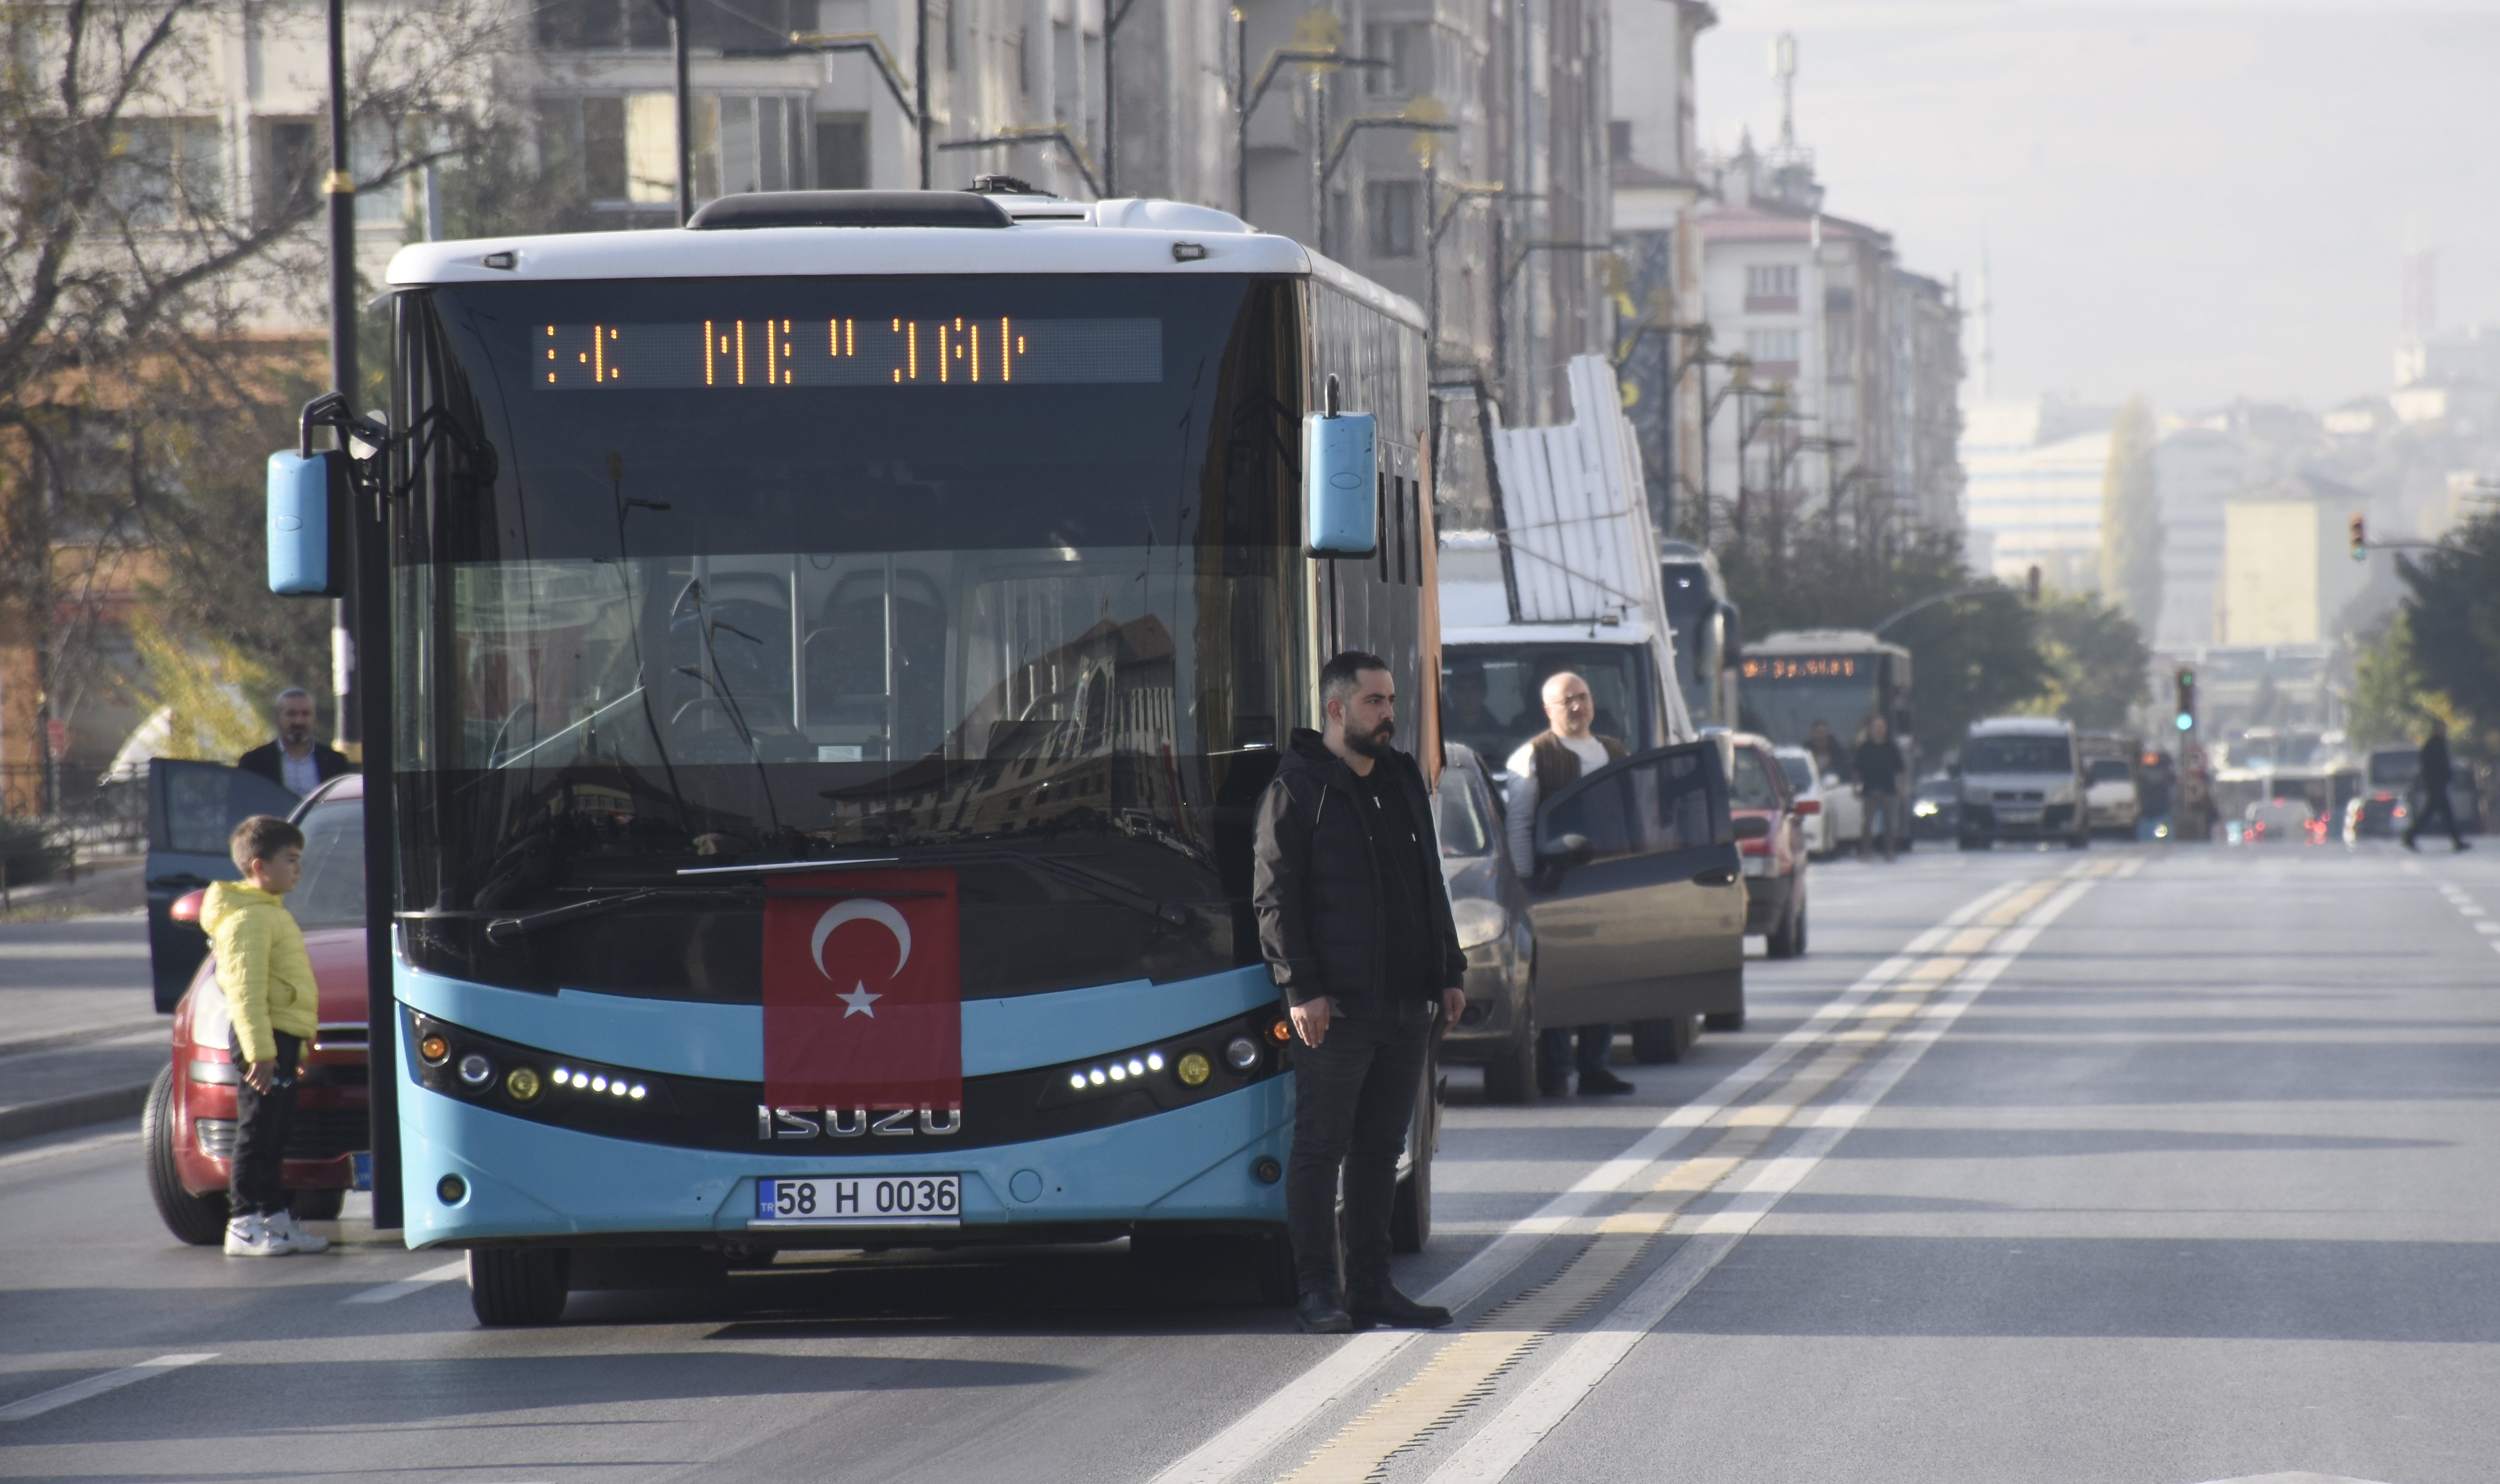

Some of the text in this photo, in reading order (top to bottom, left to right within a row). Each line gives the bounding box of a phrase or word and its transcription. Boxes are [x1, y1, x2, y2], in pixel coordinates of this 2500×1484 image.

[758, 1101, 961, 1139] ISUZU
[761, 1203, 774, 1212] TR
[776, 1179, 956, 1214] 58 H 0036
